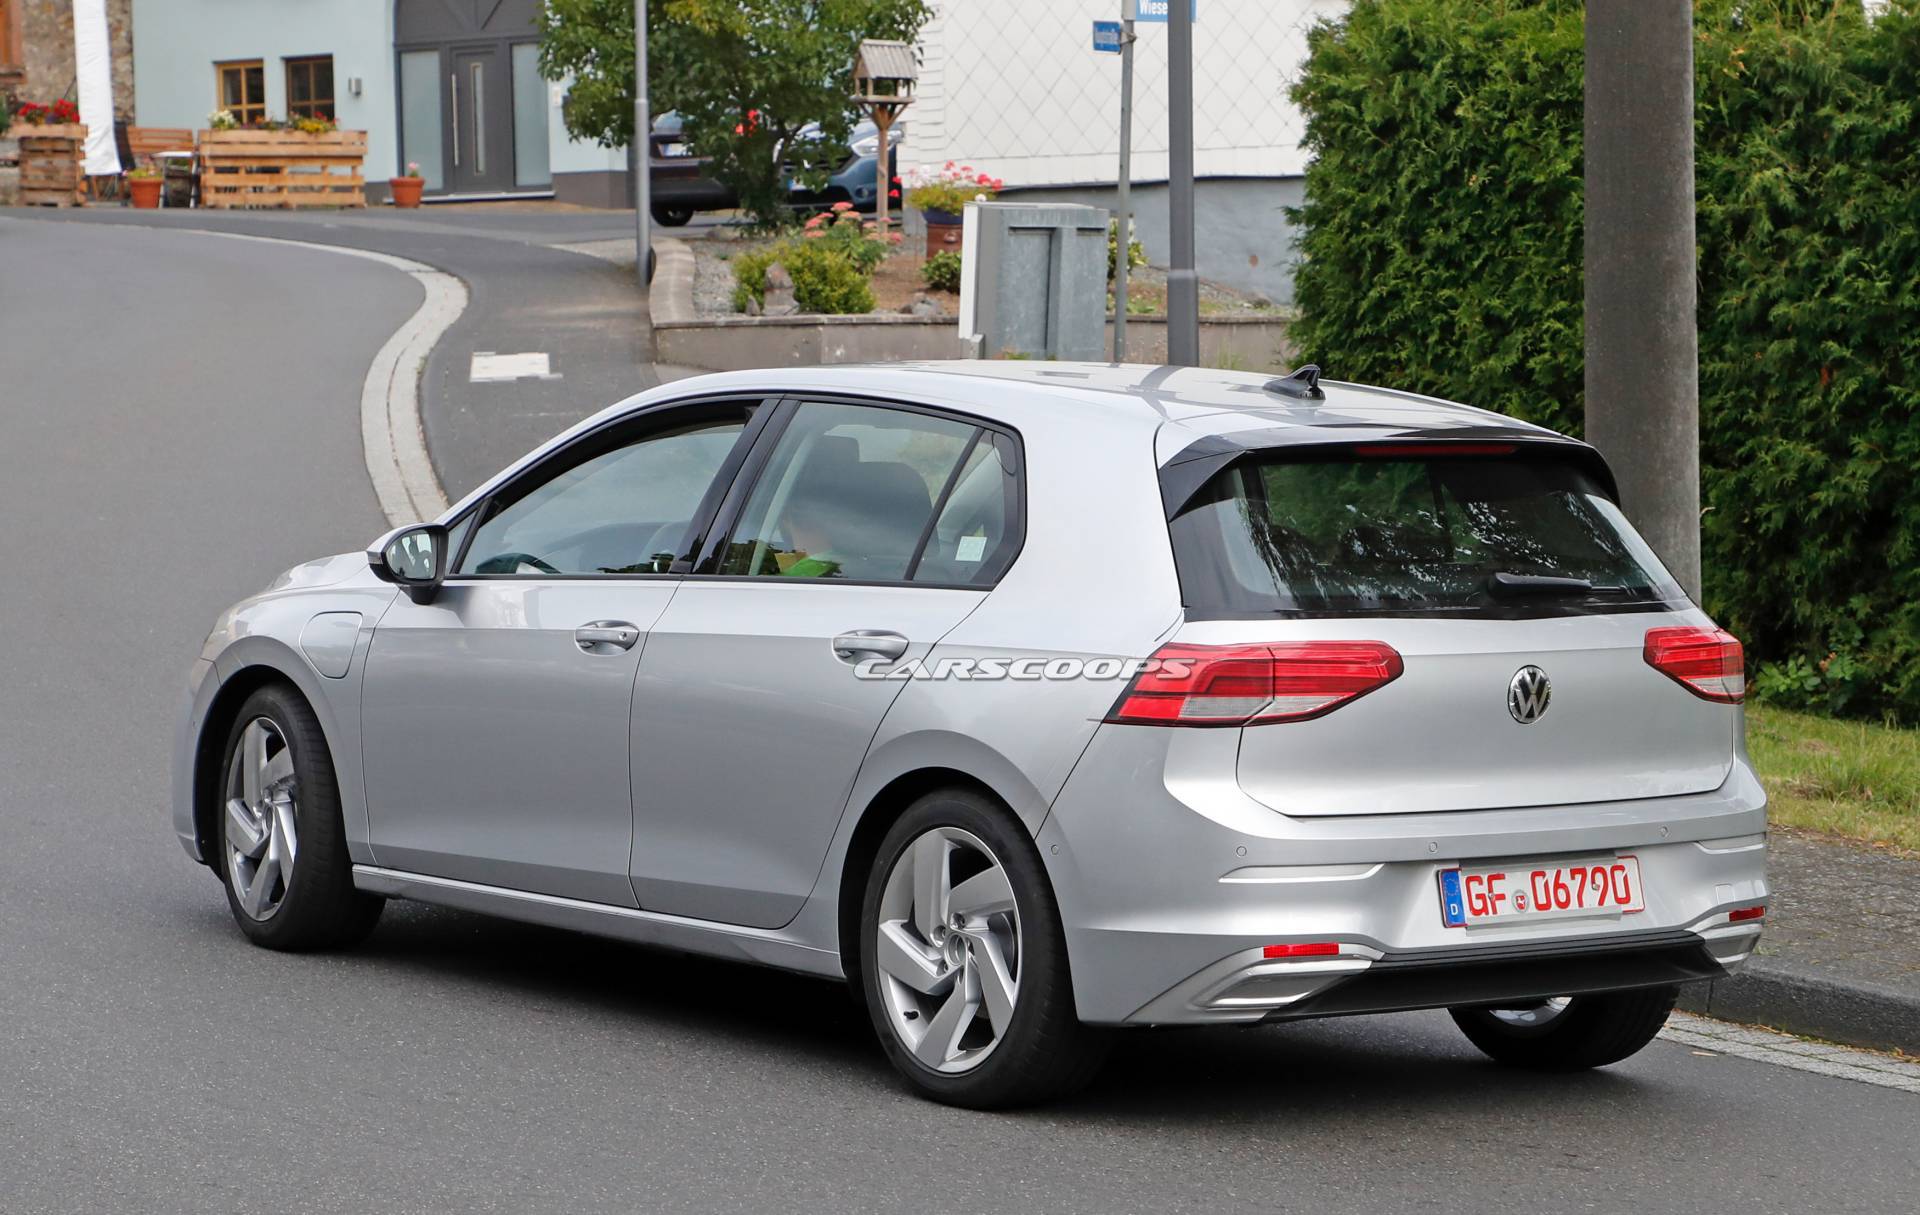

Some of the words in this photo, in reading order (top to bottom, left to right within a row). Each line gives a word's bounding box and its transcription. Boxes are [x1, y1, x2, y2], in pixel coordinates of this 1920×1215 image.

[1139, 0, 1168, 15] Wiese
[1509, 666, 1550, 722] VW
[1465, 873, 1506, 916] GF
[1530, 864, 1631, 911] 06790
[1450, 903, 1459, 916] D
